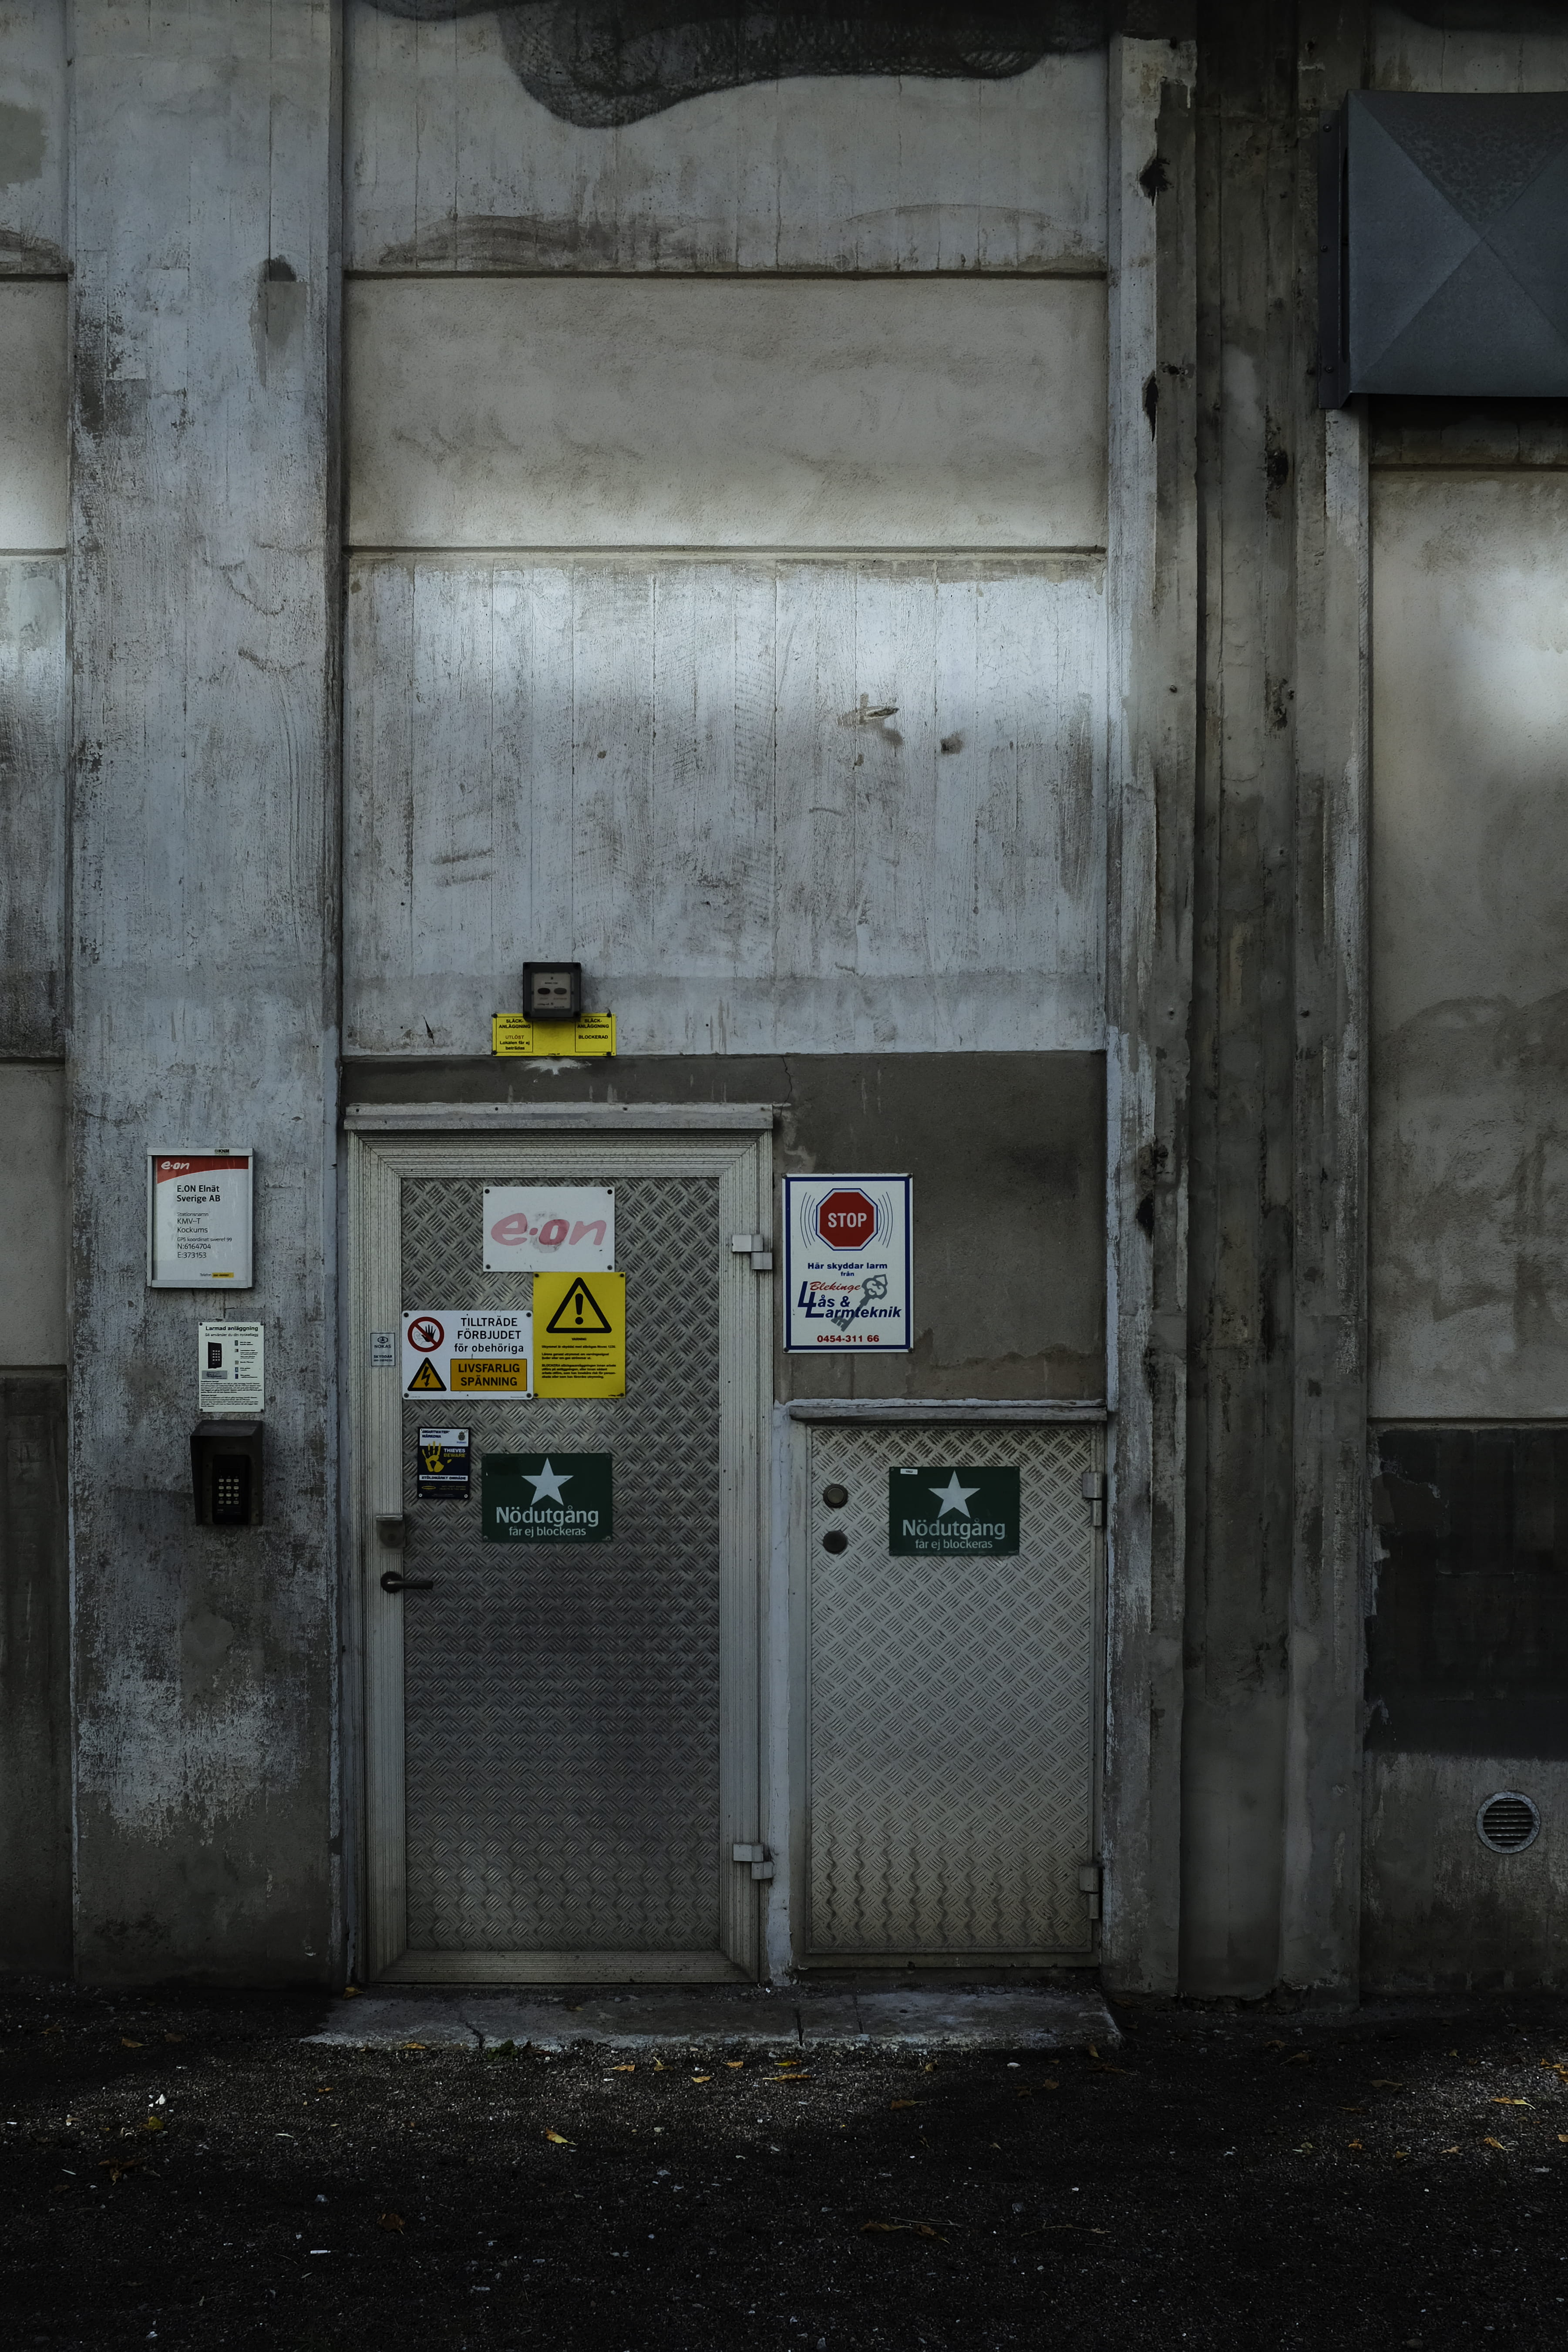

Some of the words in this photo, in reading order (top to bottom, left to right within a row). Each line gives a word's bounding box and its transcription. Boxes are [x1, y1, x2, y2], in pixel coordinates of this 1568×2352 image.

[177, 1195, 206, 1203] Sverige
[828, 1213, 866, 1227] STOP
[827, 1262, 864, 1272] skyddar
[810, 1282, 861, 1293] Blekinge
[841, 1295, 850, 1307] &
[461, 1316, 517, 1326] TILLTRÄDE
[458, 1329, 521, 1339] FÖRBJUDET
[454, 1343, 468, 1352] för
[472, 1343, 524, 1354] obehöriga
[458, 1364, 519, 1373] LIVSFARLIG
[461, 1375, 517, 1386] SPÄNNING
[497, 1505, 599, 1527] Nödutgång
[509, 1527, 522, 1535] får
[525, 1527, 533, 1538] ej
[537, 1527, 586, 1535] blockeras
[903, 1518, 1005, 1540] Nödutgång
[915, 1540, 929, 1548] får
[932, 1540, 940, 1550] ej
[944, 1540, 993, 1548] blockeras
